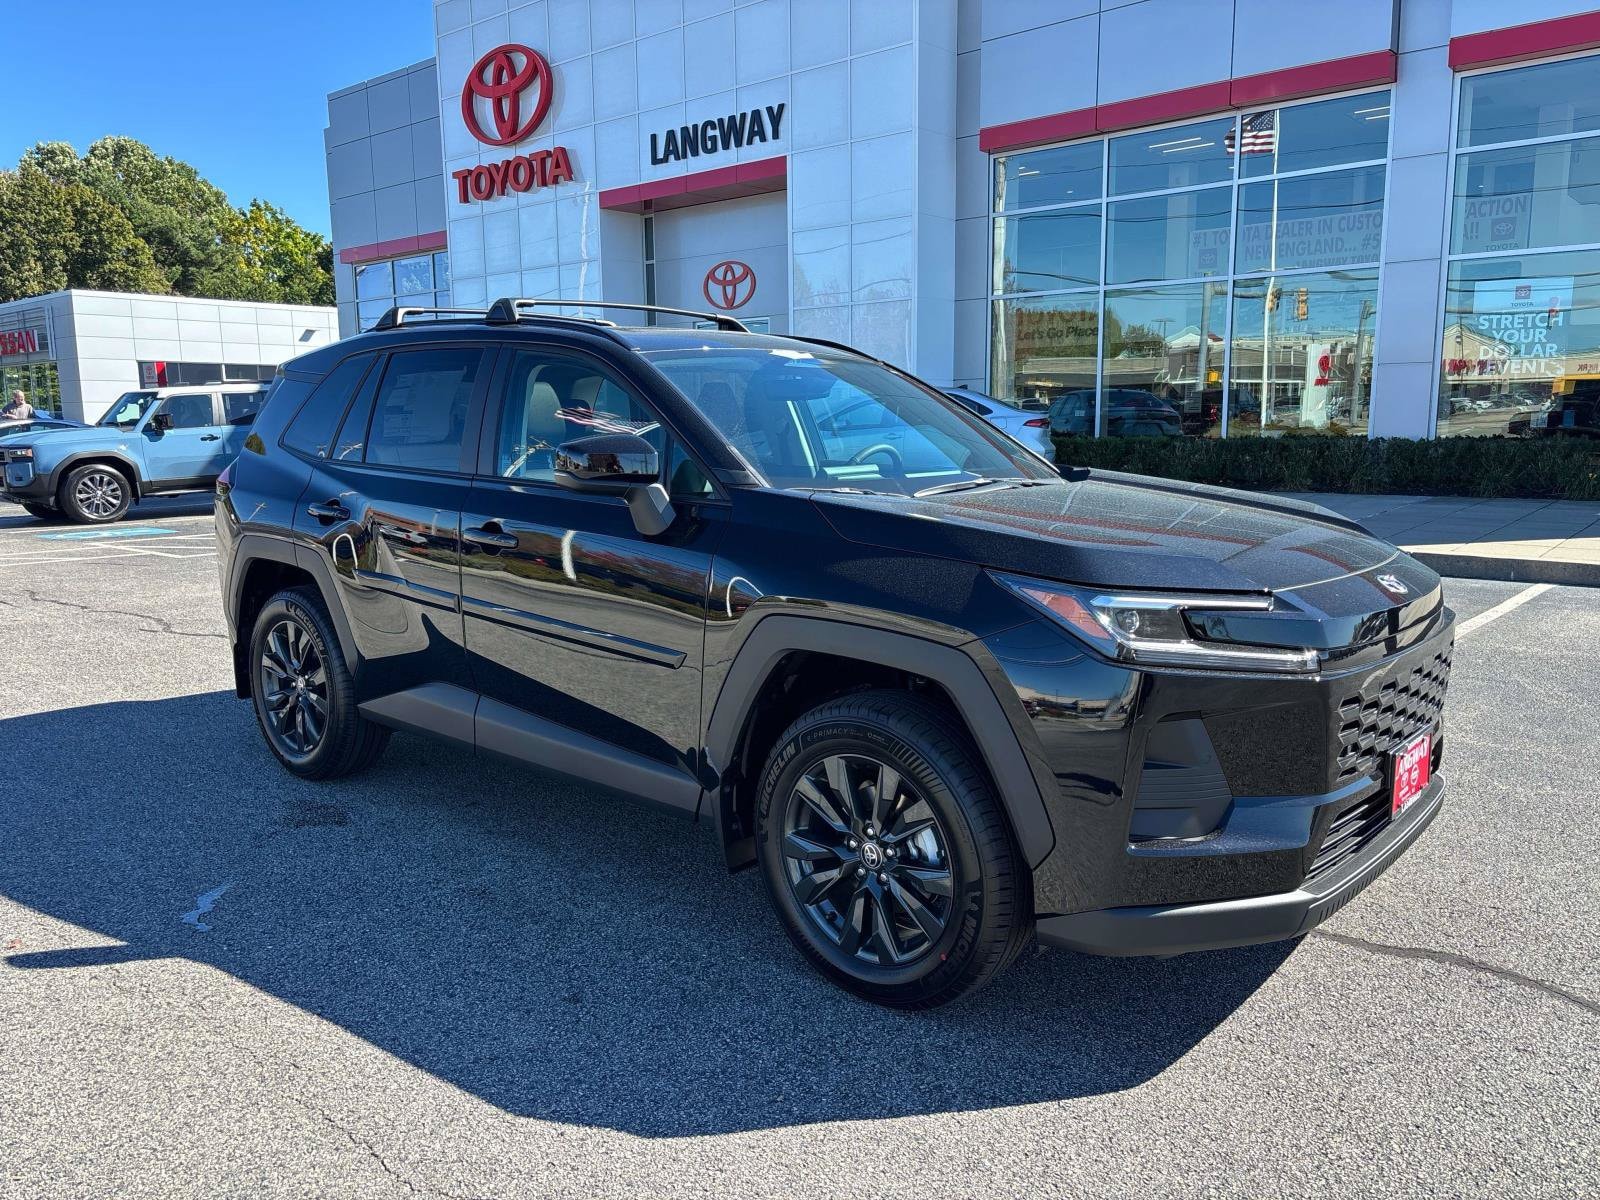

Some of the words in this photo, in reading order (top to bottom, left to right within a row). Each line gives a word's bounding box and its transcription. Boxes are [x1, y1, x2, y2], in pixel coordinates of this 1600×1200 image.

[650, 103, 786, 165] LANGWAY
[452, 146, 574, 204] TOYOTA
[1465, 196, 1527, 219] ACTION
[1480, 312, 1564, 330] STRETCH
[1492, 328, 1547, 343] YOUR
[1480, 343, 1558, 360] DOLLAR
[760, 741, 797, 817] MICHELIN
